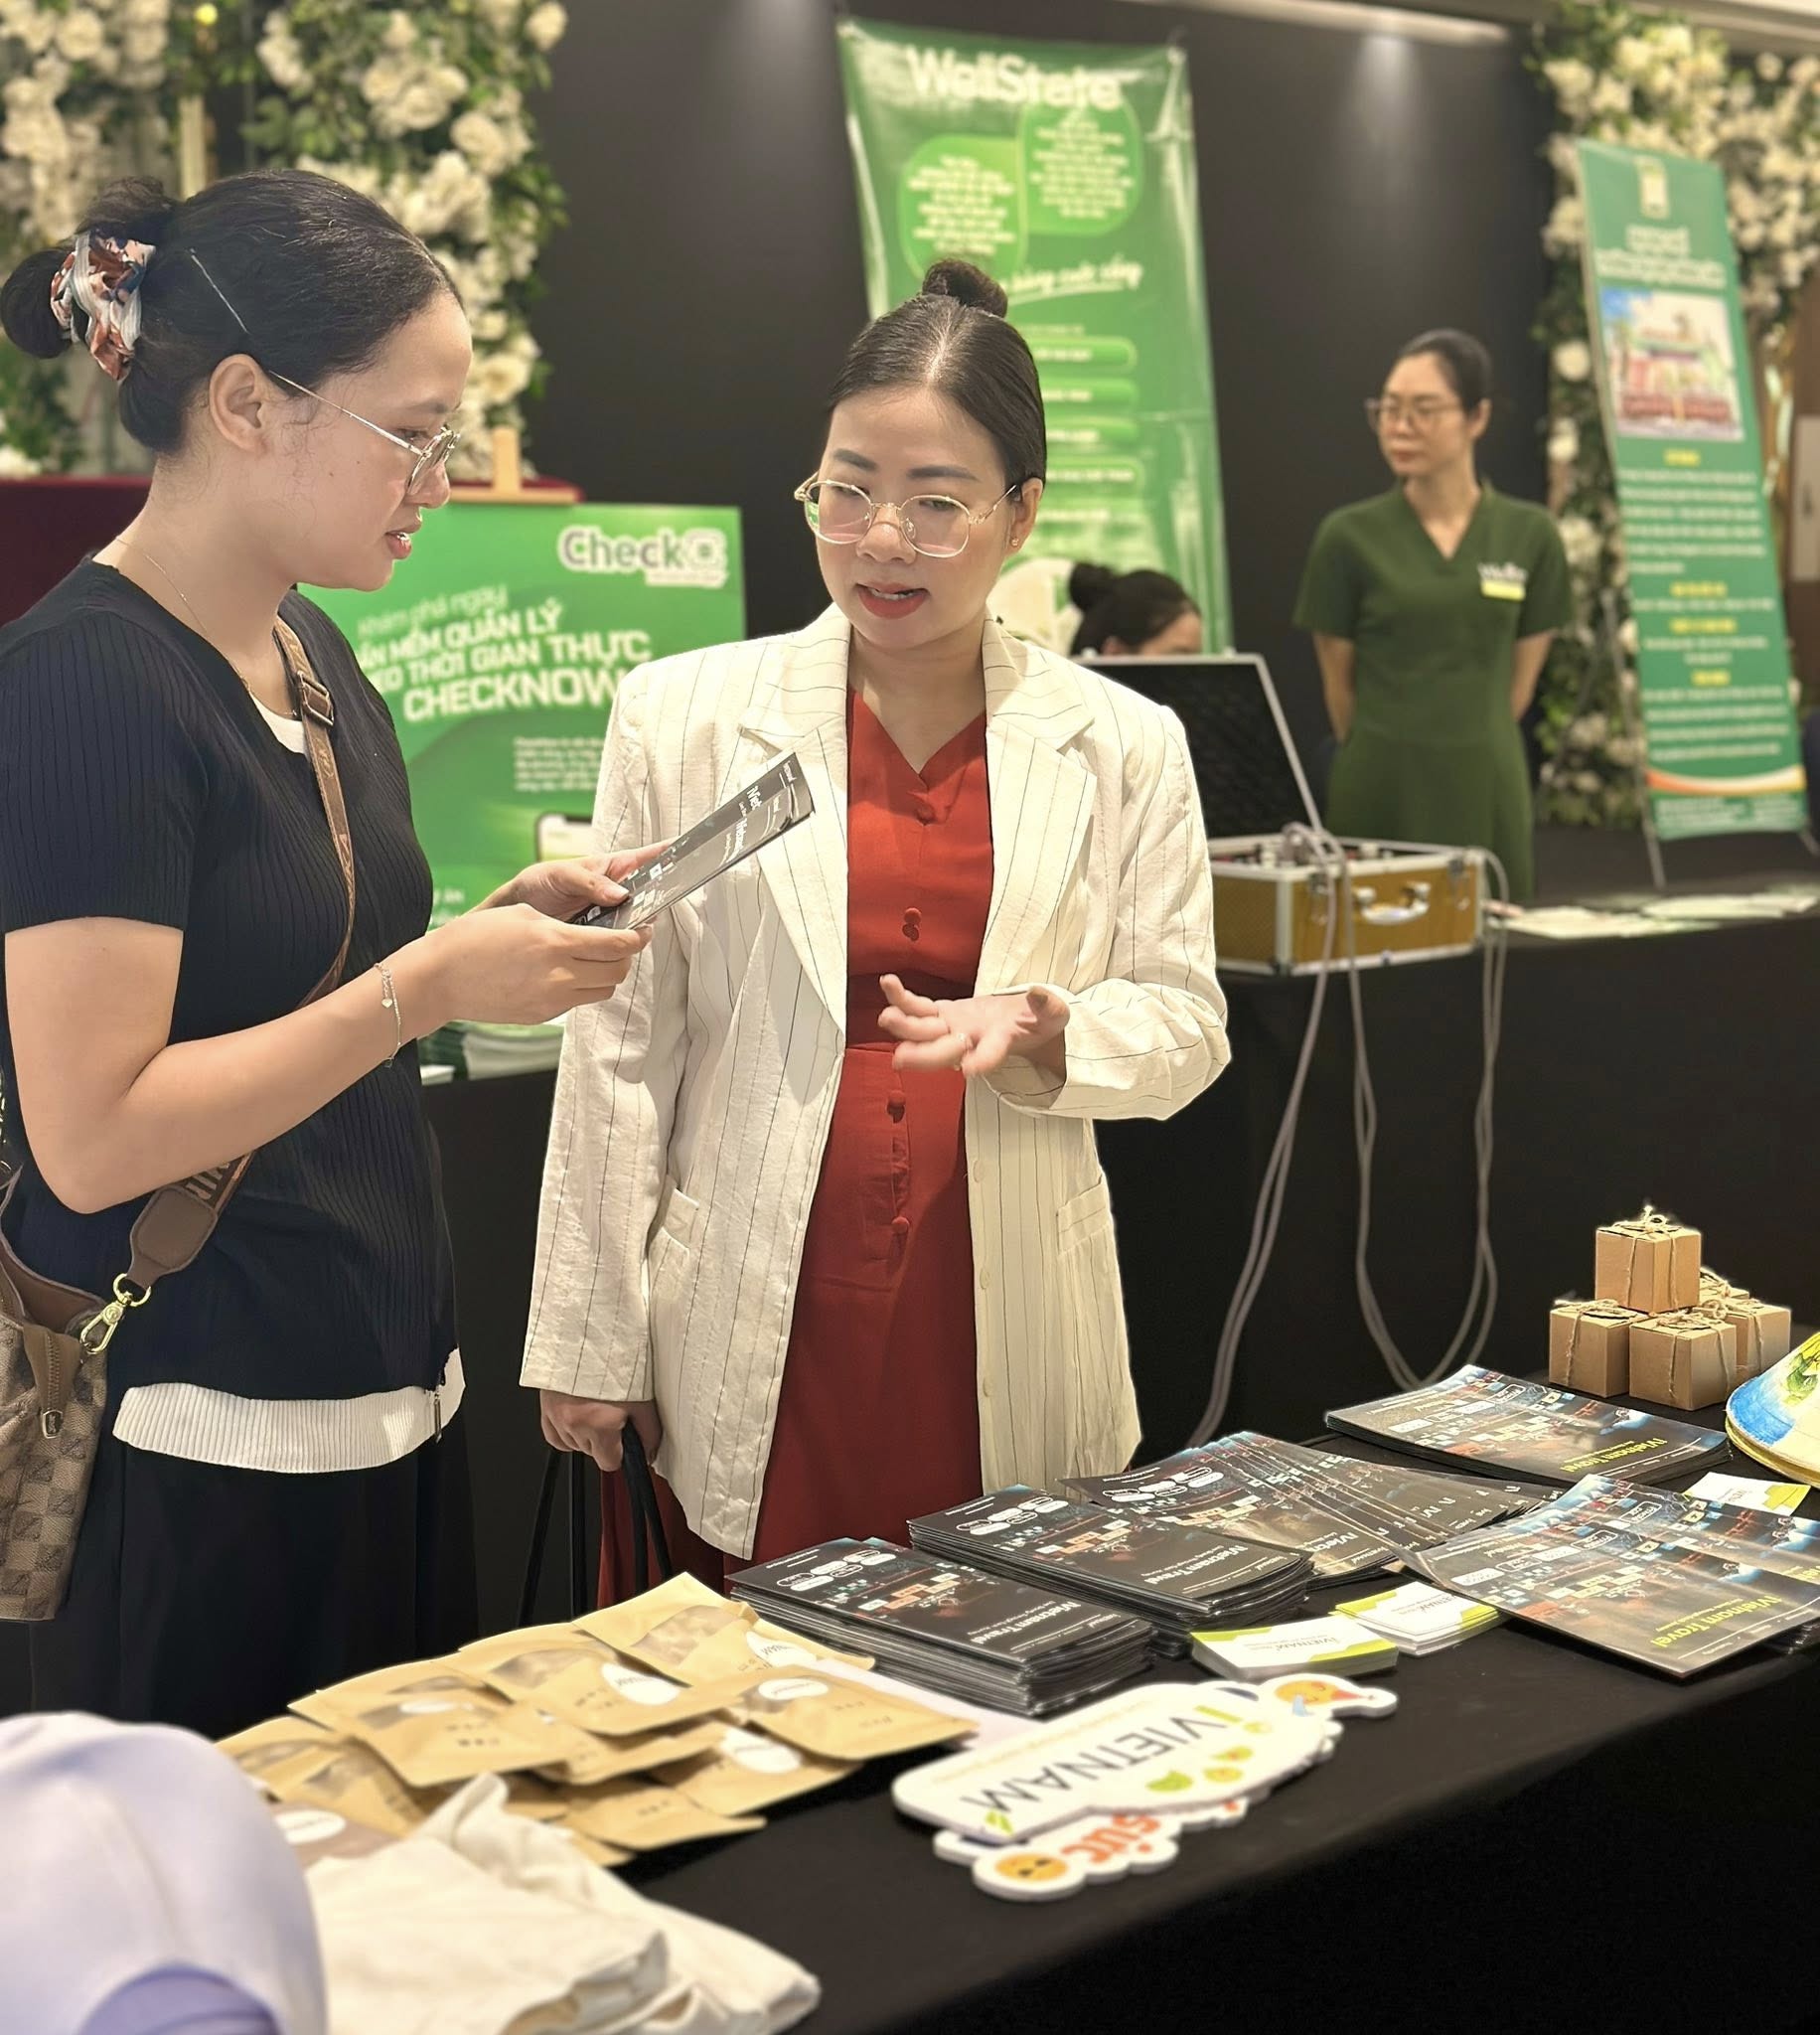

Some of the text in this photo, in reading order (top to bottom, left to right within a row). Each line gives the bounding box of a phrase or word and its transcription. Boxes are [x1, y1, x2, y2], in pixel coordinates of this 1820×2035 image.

[470, 637, 541, 673] GIAN
[546, 628, 653, 671] THỰC
[1650, 1623, 1711, 1647] Travel
